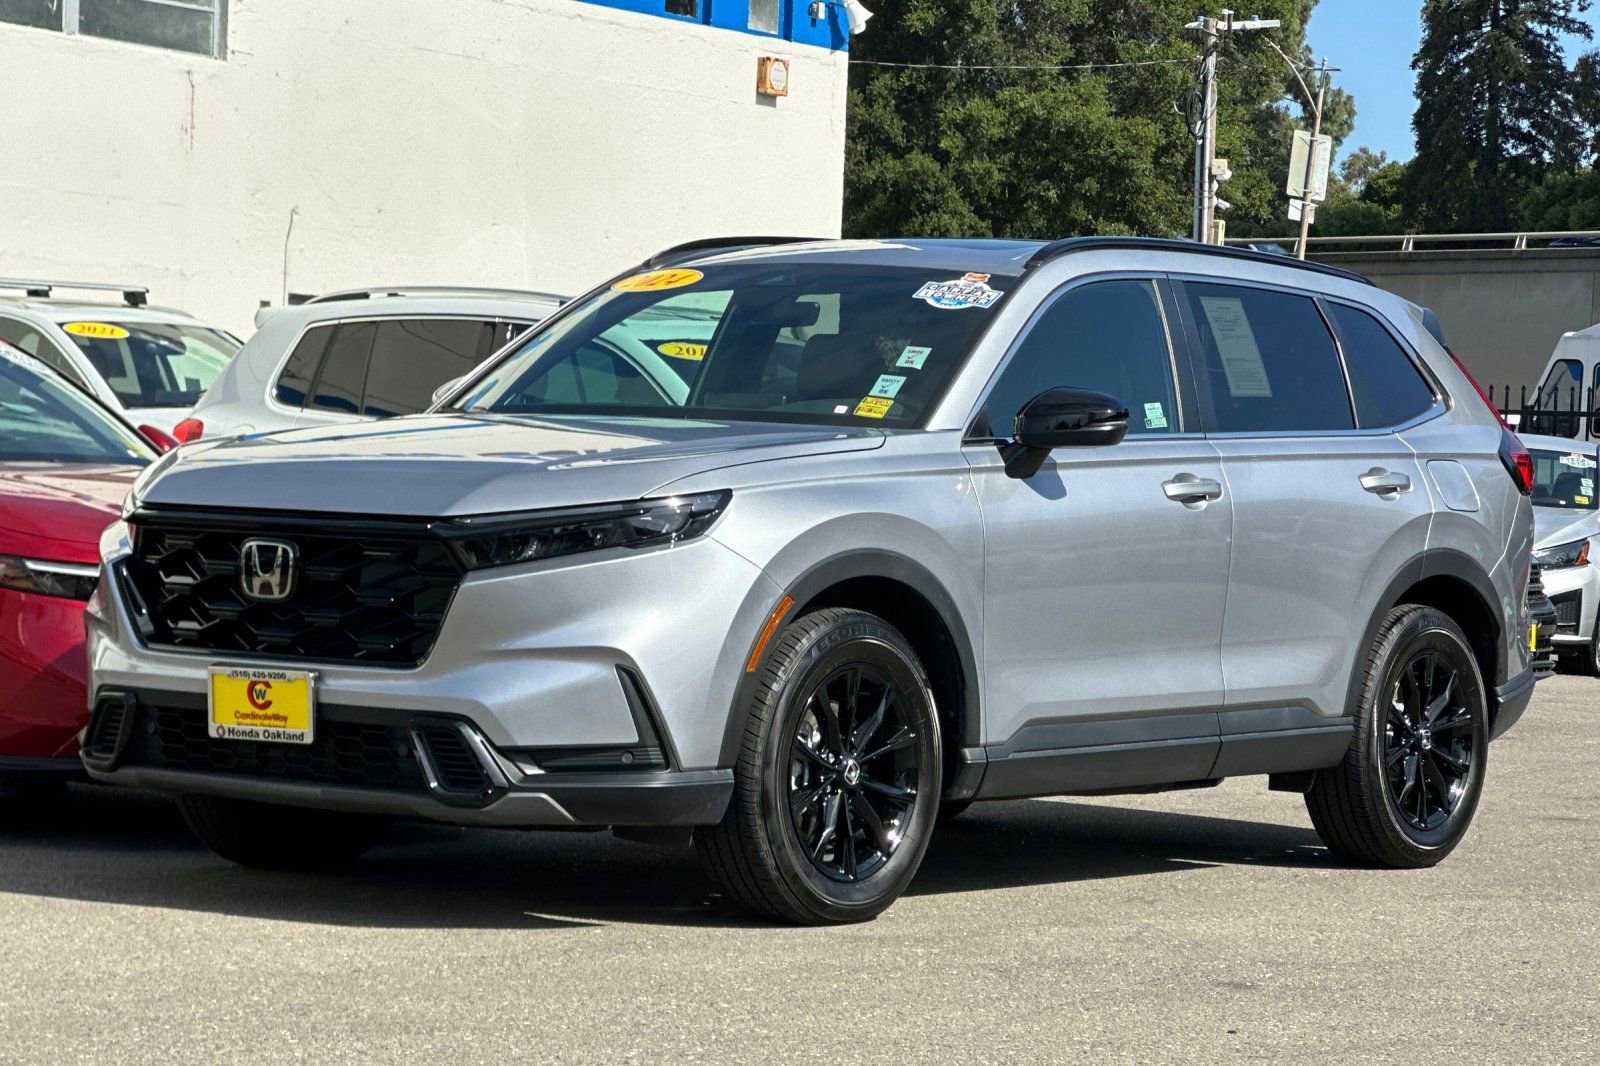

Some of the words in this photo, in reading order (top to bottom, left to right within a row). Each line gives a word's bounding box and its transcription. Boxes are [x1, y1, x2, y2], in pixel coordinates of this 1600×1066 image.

[928, 284, 992, 299] CARFAX
[931, 291, 988, 304] OWNER
[674, 345, 705, 357] 201
[231, 670, 251, 680] (510)
[252, 671, 287, 680] 420-9200
[234, 711, 289, 724] CardinaleWay
[227, 727, 260, 739] Honda
[263, 729, 305, 742] Oakland
